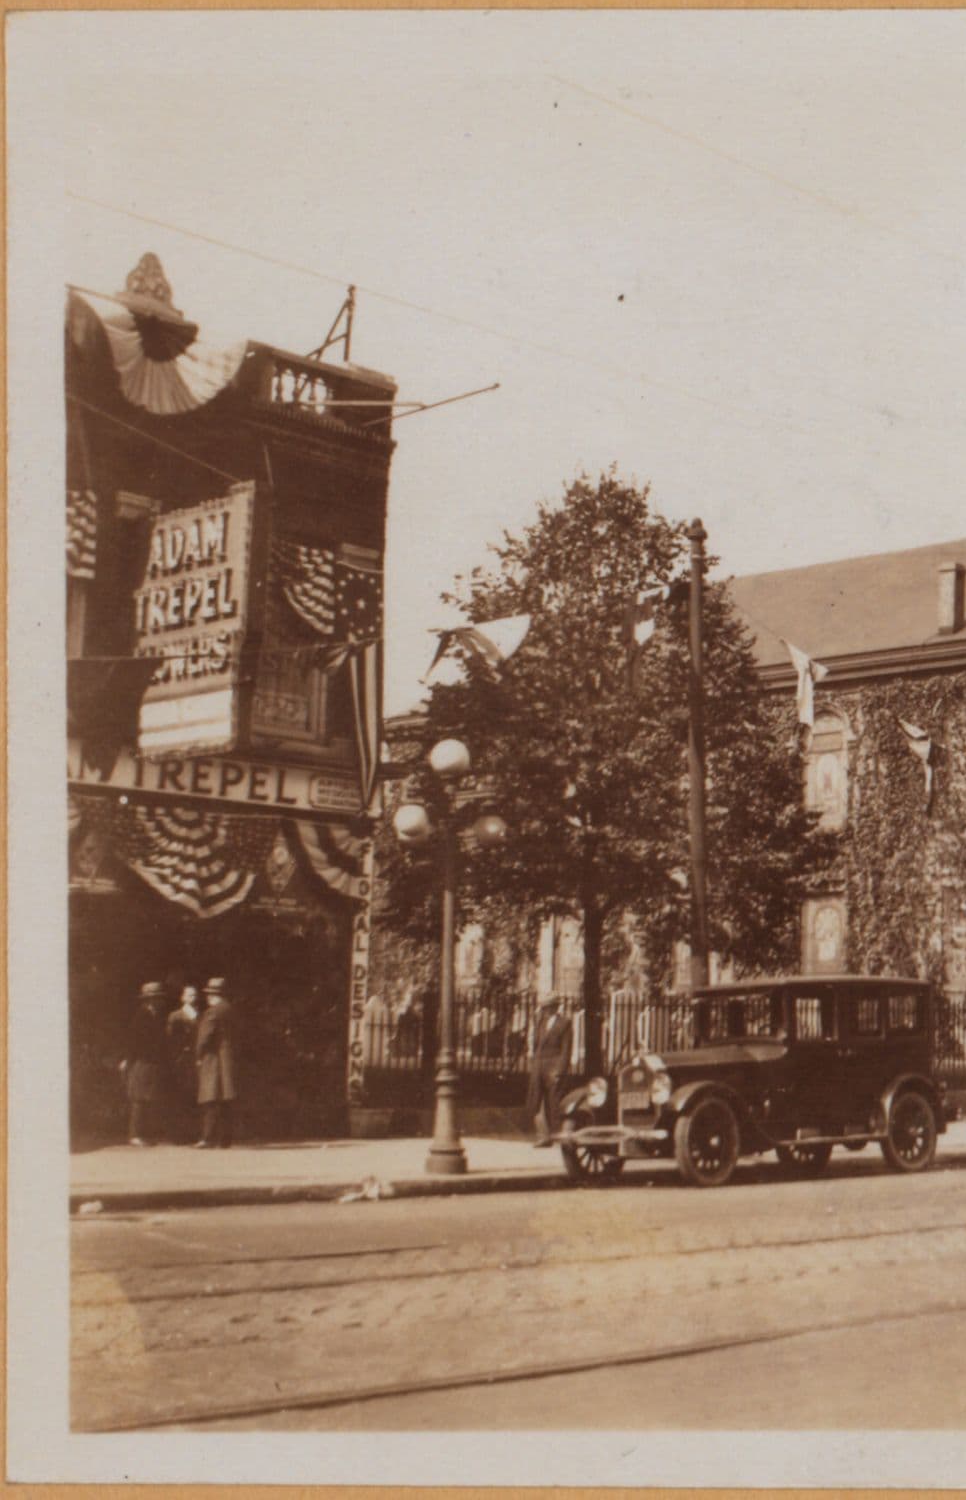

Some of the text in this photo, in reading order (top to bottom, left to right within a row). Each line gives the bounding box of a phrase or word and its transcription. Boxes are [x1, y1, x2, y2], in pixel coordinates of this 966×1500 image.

[149, 510, 231, 579] ADAM
[135, 567, 237, 636] TREPEL
[131, 756, 297, 805] TREPEL
[348, 963, 367, 1094] DESIGNS
